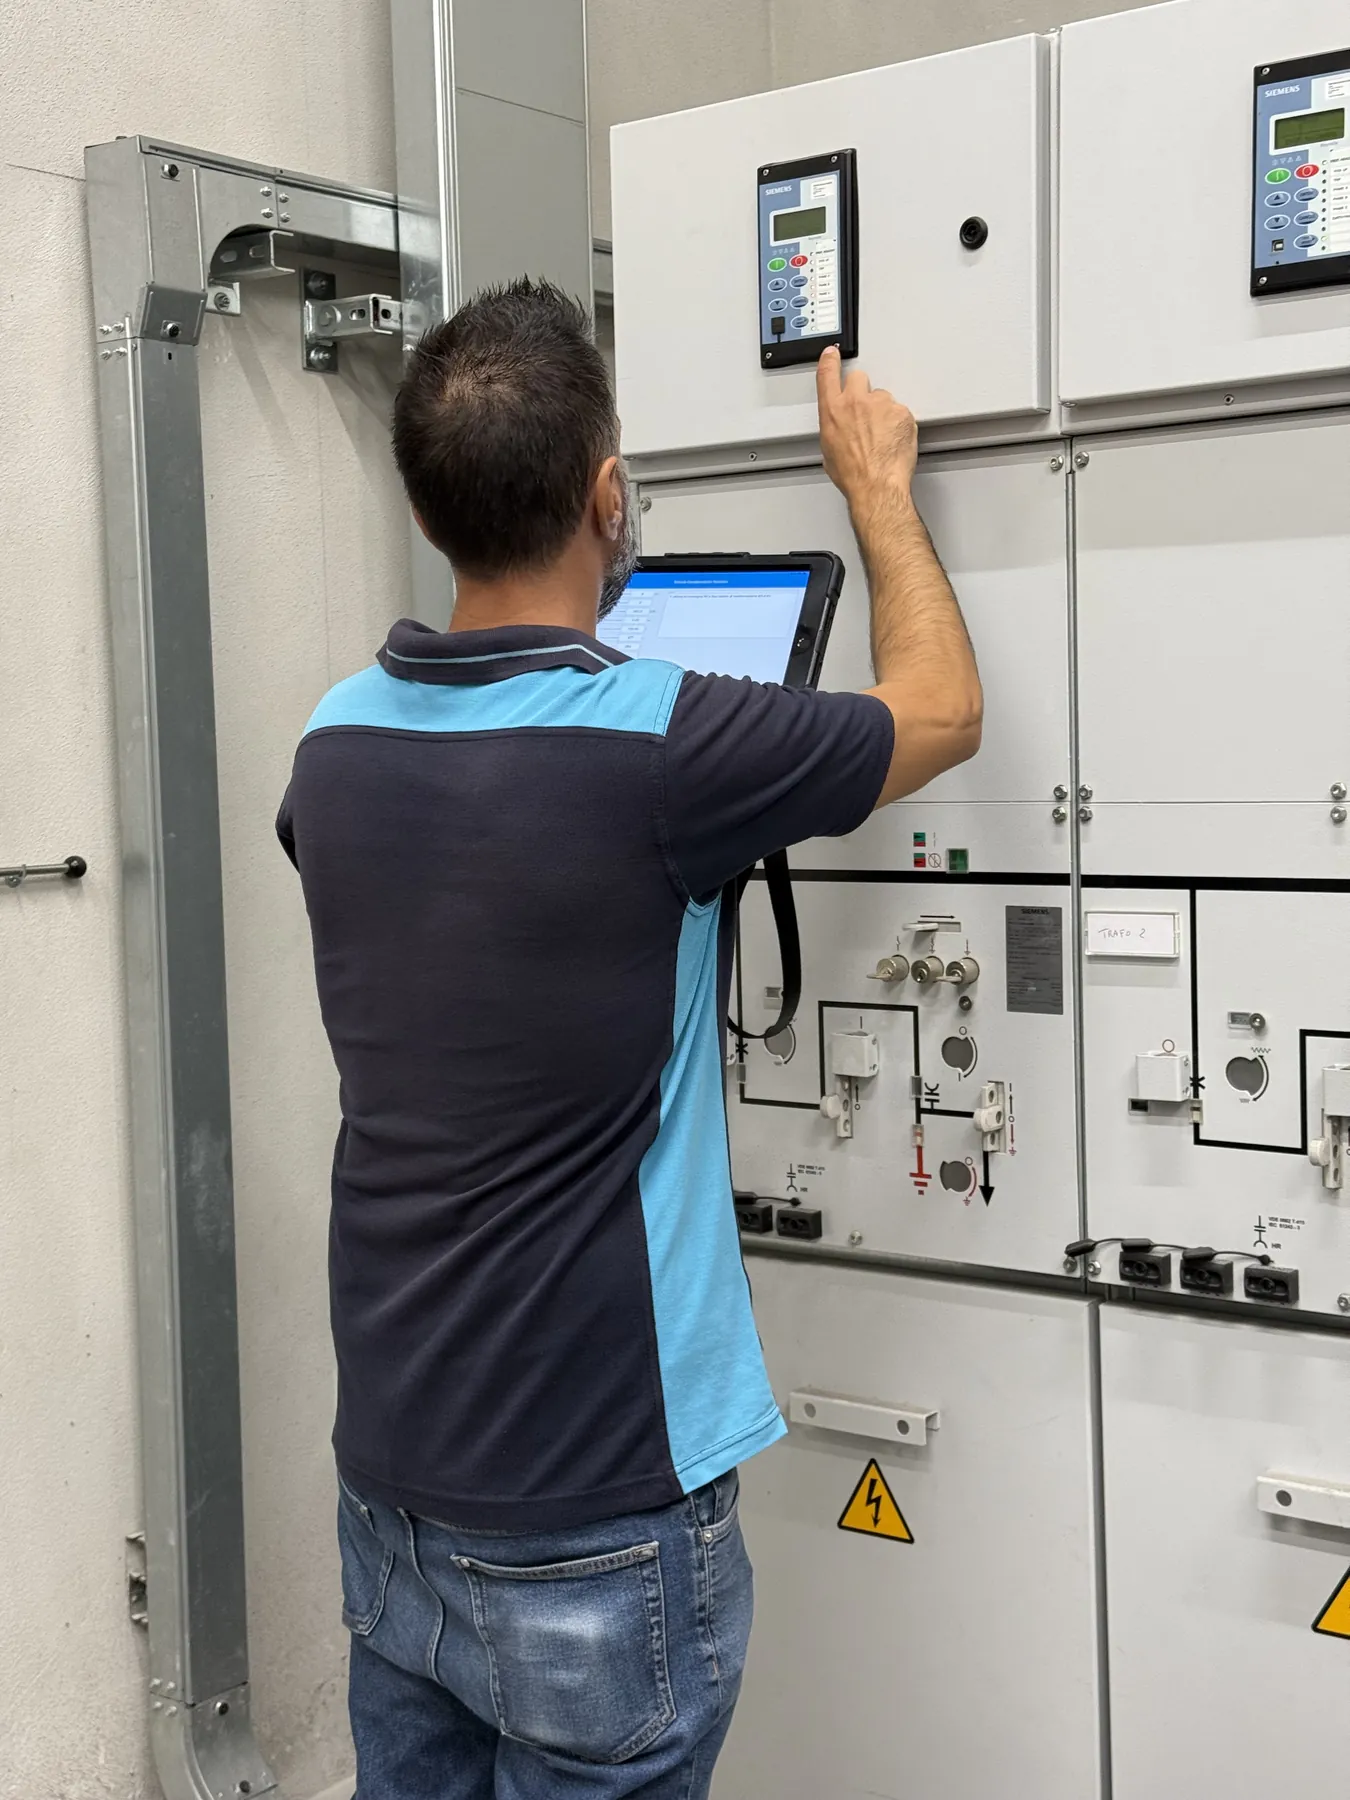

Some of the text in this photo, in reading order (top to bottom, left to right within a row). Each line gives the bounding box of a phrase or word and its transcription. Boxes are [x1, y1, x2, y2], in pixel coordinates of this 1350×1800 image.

[1264, 84, 1301, 98] SIEMENS
[765, 185, 792, 196] SIEMENS
[1098, 928, 1146, 939] TRAFO 2
